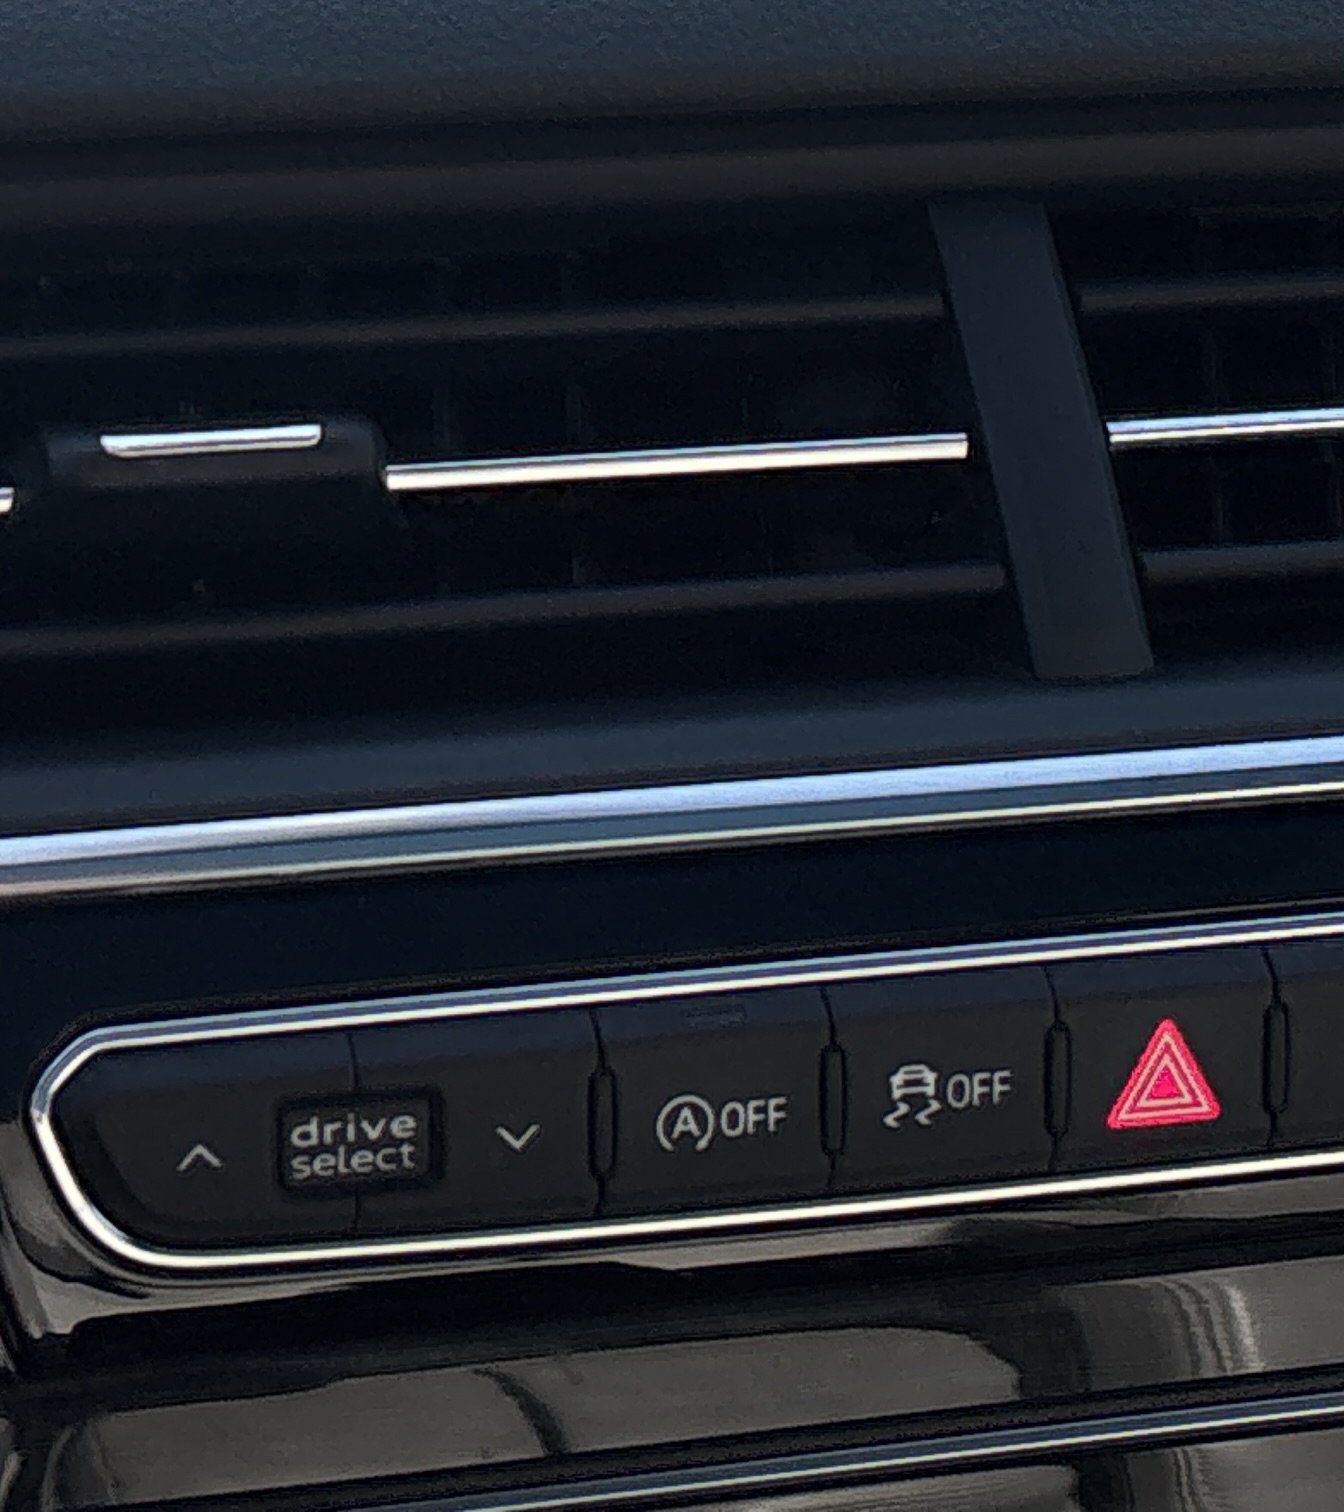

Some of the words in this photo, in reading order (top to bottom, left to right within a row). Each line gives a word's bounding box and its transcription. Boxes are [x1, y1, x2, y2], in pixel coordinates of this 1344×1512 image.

[946, 1070, 1012, 1109] OFF
[290, 1112, 417, 1148] drive
[719, 1096, 788, 1138] OFF
[291, 1143, 417, 1179] select
